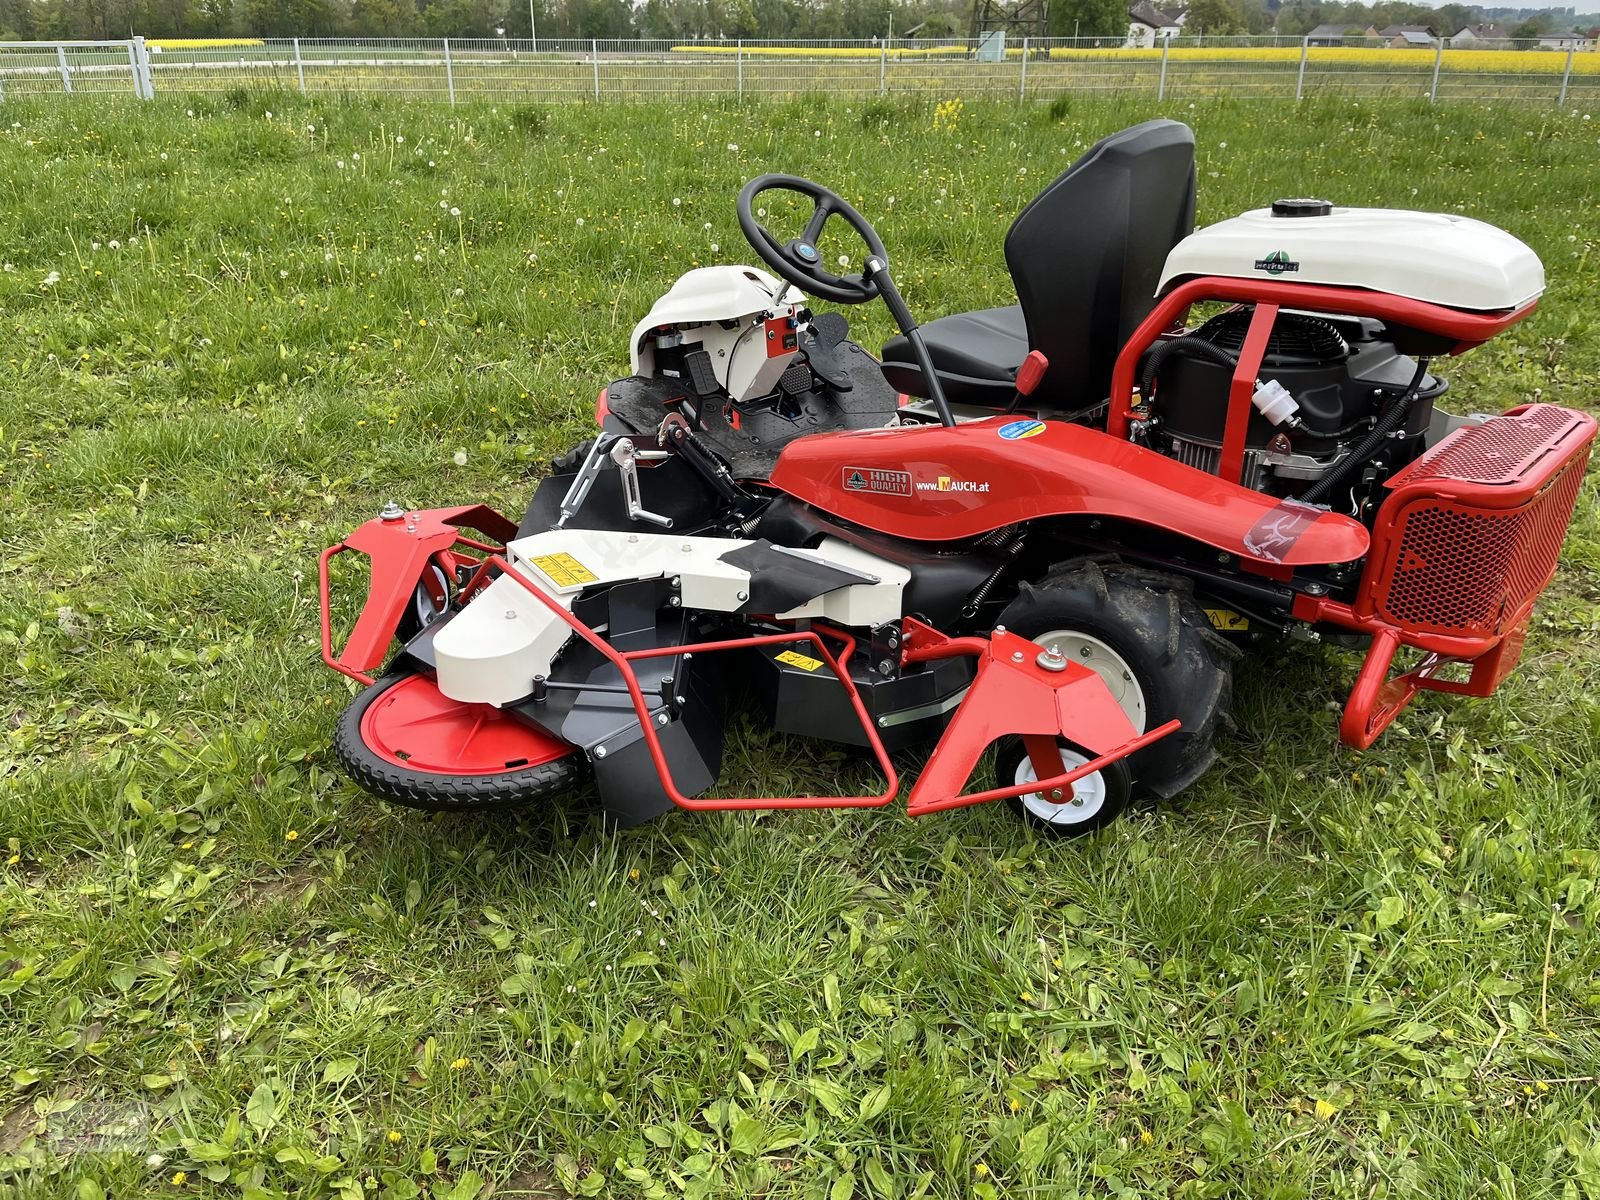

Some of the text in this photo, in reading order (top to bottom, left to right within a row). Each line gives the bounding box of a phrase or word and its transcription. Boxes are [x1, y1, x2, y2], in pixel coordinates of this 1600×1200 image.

[870, 471, 907, 483] HIGH
[870, 480, 907, 493] QUALITY
[916, 477, 990, 492] www.MAUCH.at
